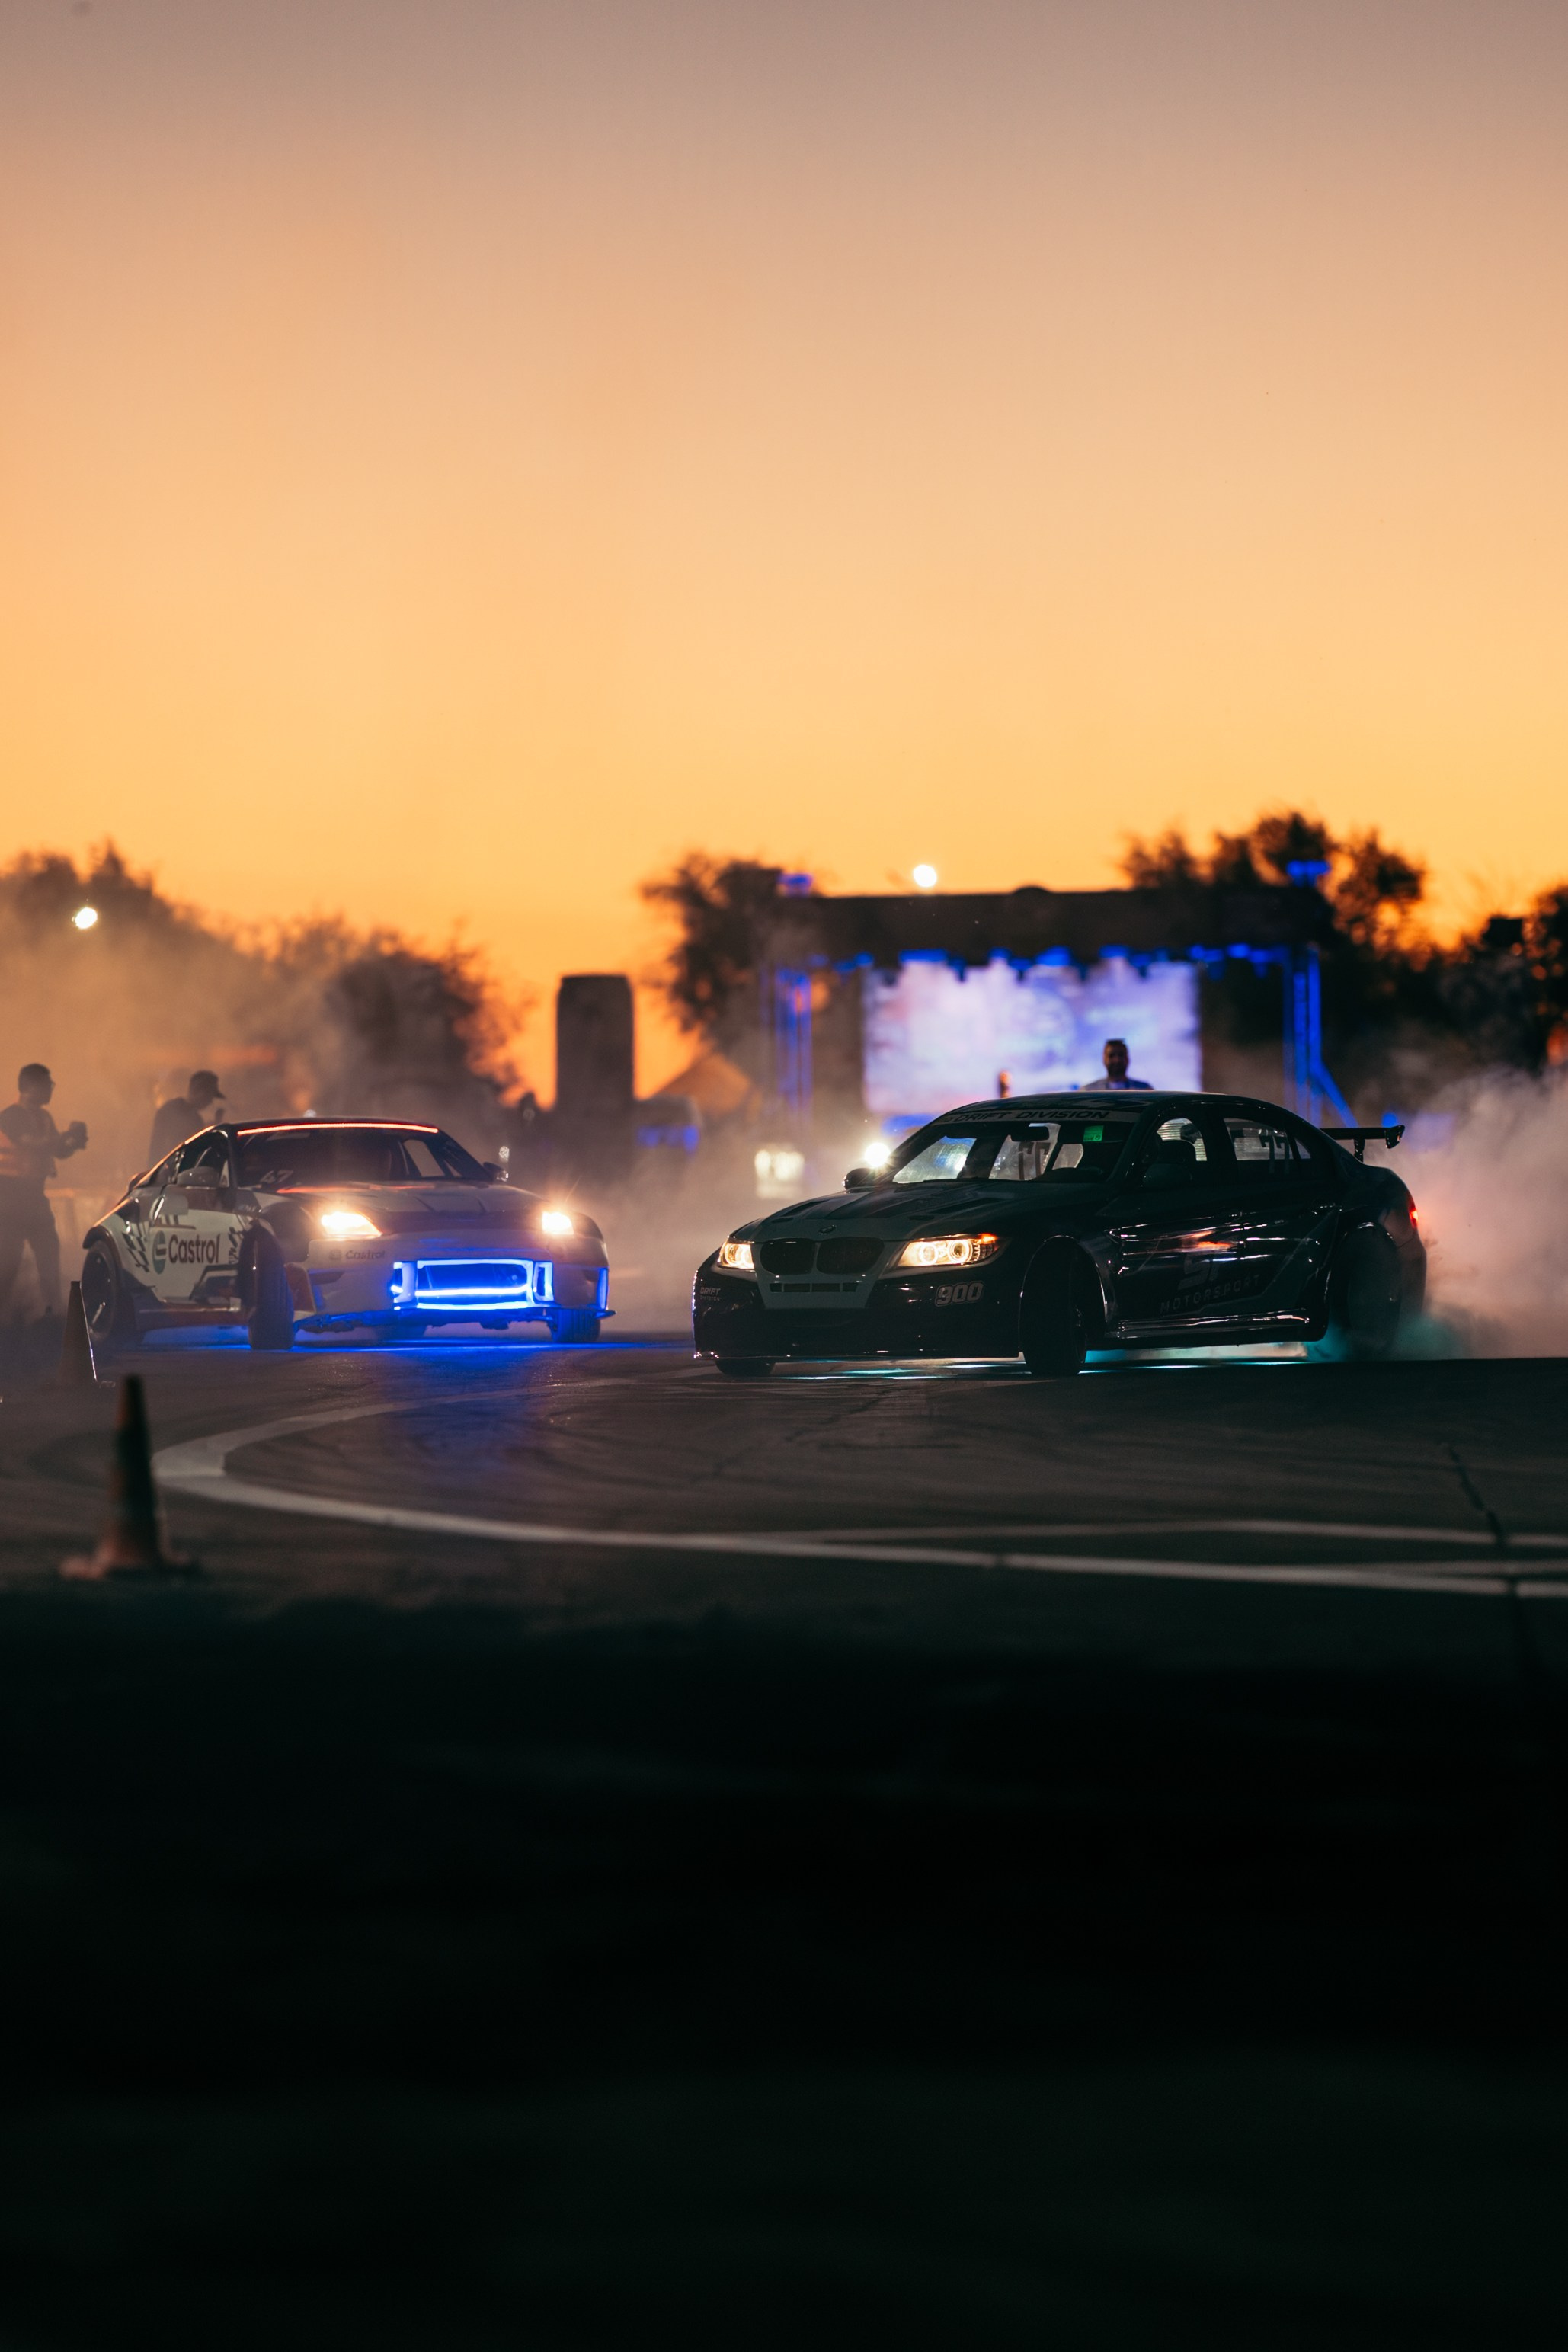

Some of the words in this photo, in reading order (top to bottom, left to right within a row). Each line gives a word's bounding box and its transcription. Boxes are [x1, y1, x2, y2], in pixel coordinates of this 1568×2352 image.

[954, 1112, 1012, 1122] DRIFT
[168, 1234, 220, 1263] Castrol
[346, 1250, 385, 1259] Castrol
[700, 1286, 721, 1295] DRIFT
[936, 1282, 984, 1305] 900
[1159, 1275, 1260, 1314] MOTORSPORT
